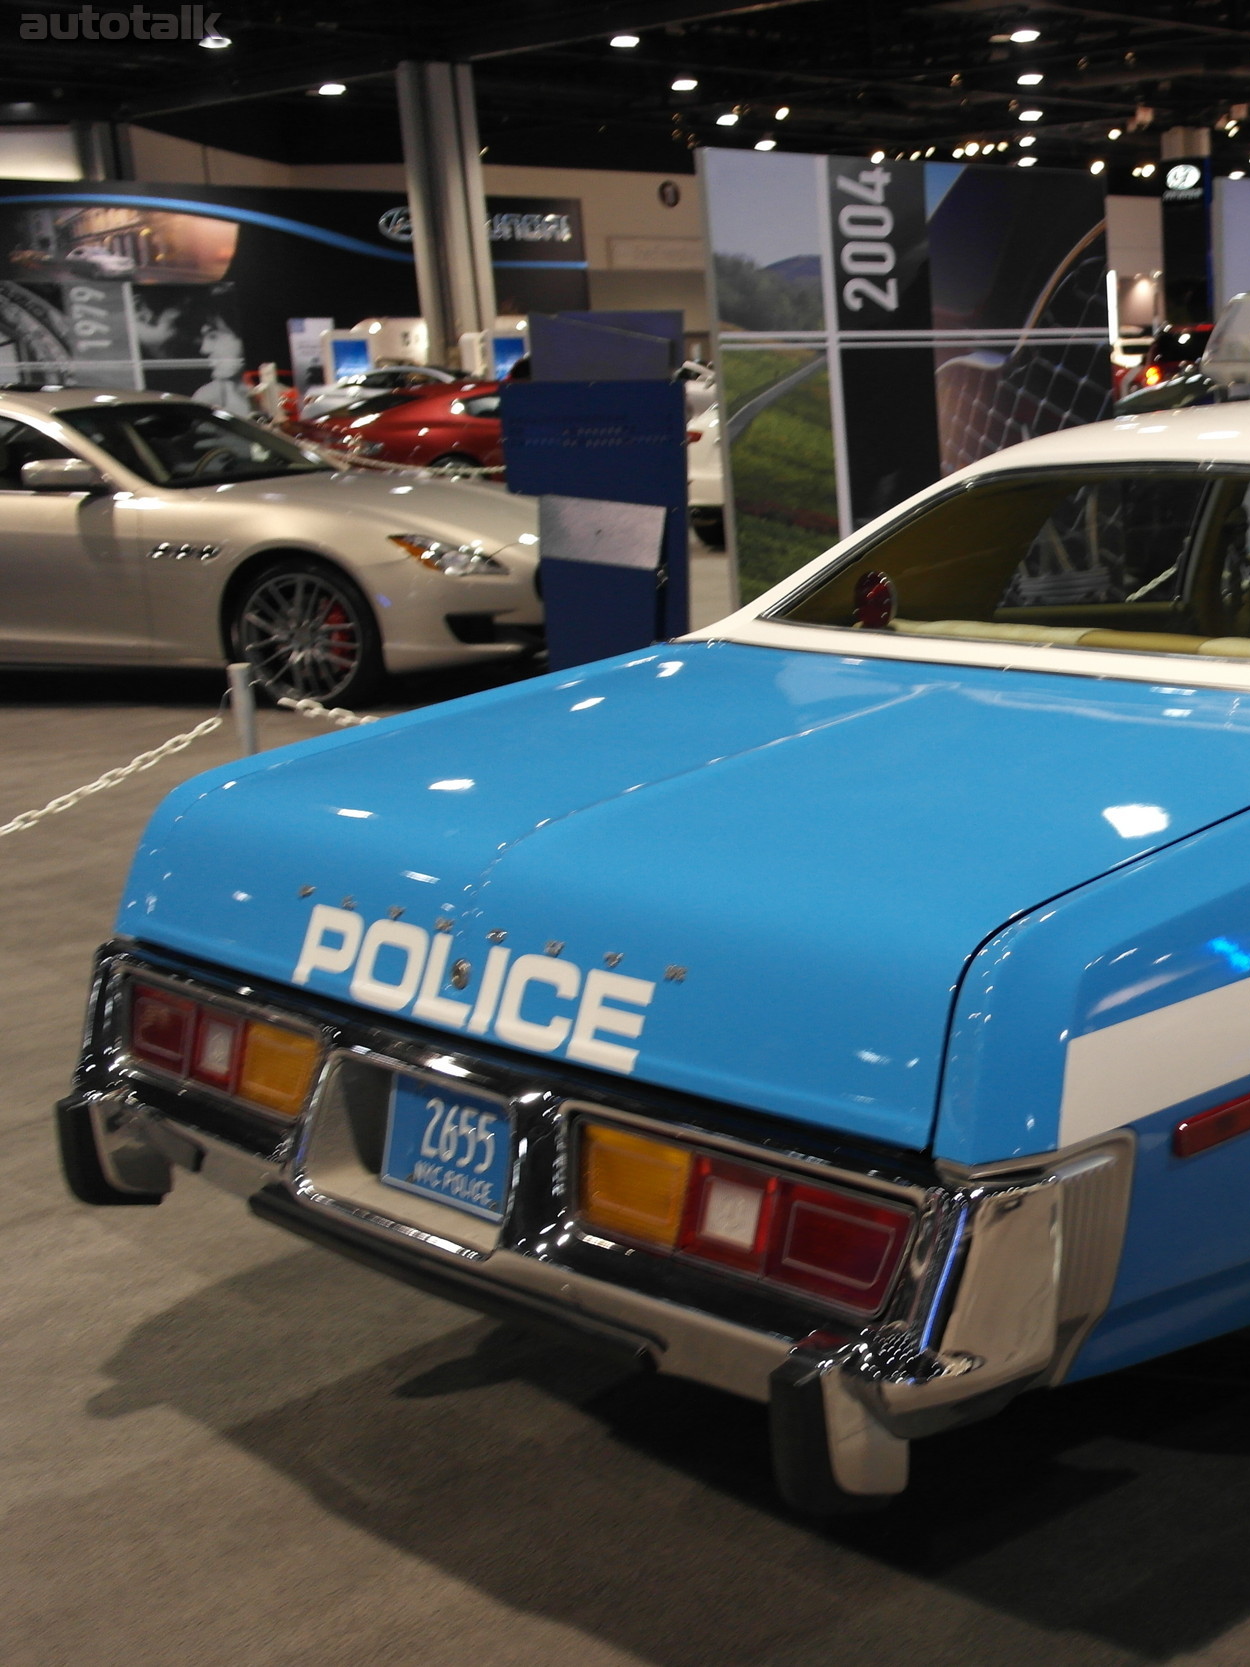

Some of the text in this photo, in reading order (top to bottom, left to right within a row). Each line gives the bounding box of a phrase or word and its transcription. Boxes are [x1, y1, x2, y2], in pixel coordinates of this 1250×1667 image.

[836, 167, 899, 312] 2004
[69, 286, 112, 352] 1979
[291, 903, 657, 1074] POLICE
[420, 1097, 498, 1174] 2655
[413, 1160, 495, 1206] NYC POLICE
